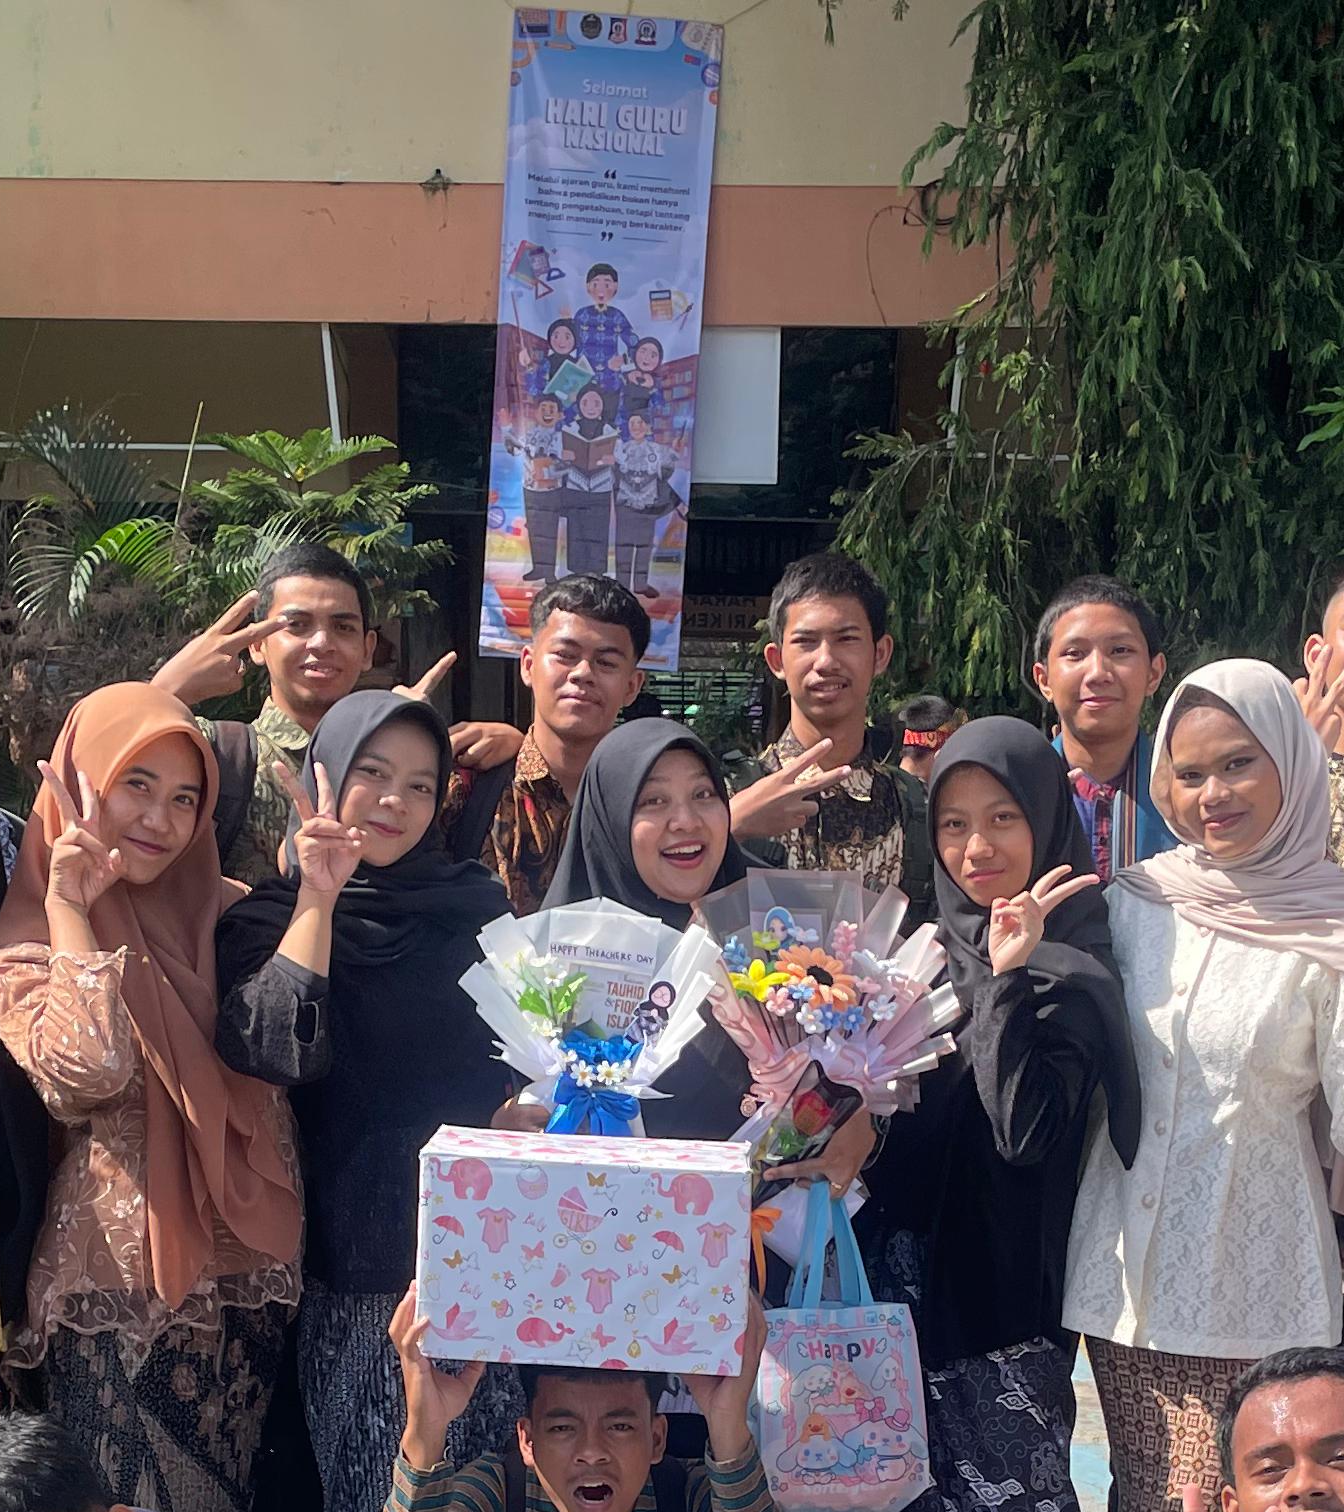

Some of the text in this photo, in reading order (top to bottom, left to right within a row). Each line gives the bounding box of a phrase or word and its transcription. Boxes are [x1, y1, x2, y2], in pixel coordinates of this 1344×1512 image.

[583, 79, 648, 99] Selamat
[545, 98, 688, 135] HARI GURU
[563, 127, 665, 157] NASIONAL
[637, 955, 654, 963] DAY
[607, 981, 644, 1000] TAUHID
